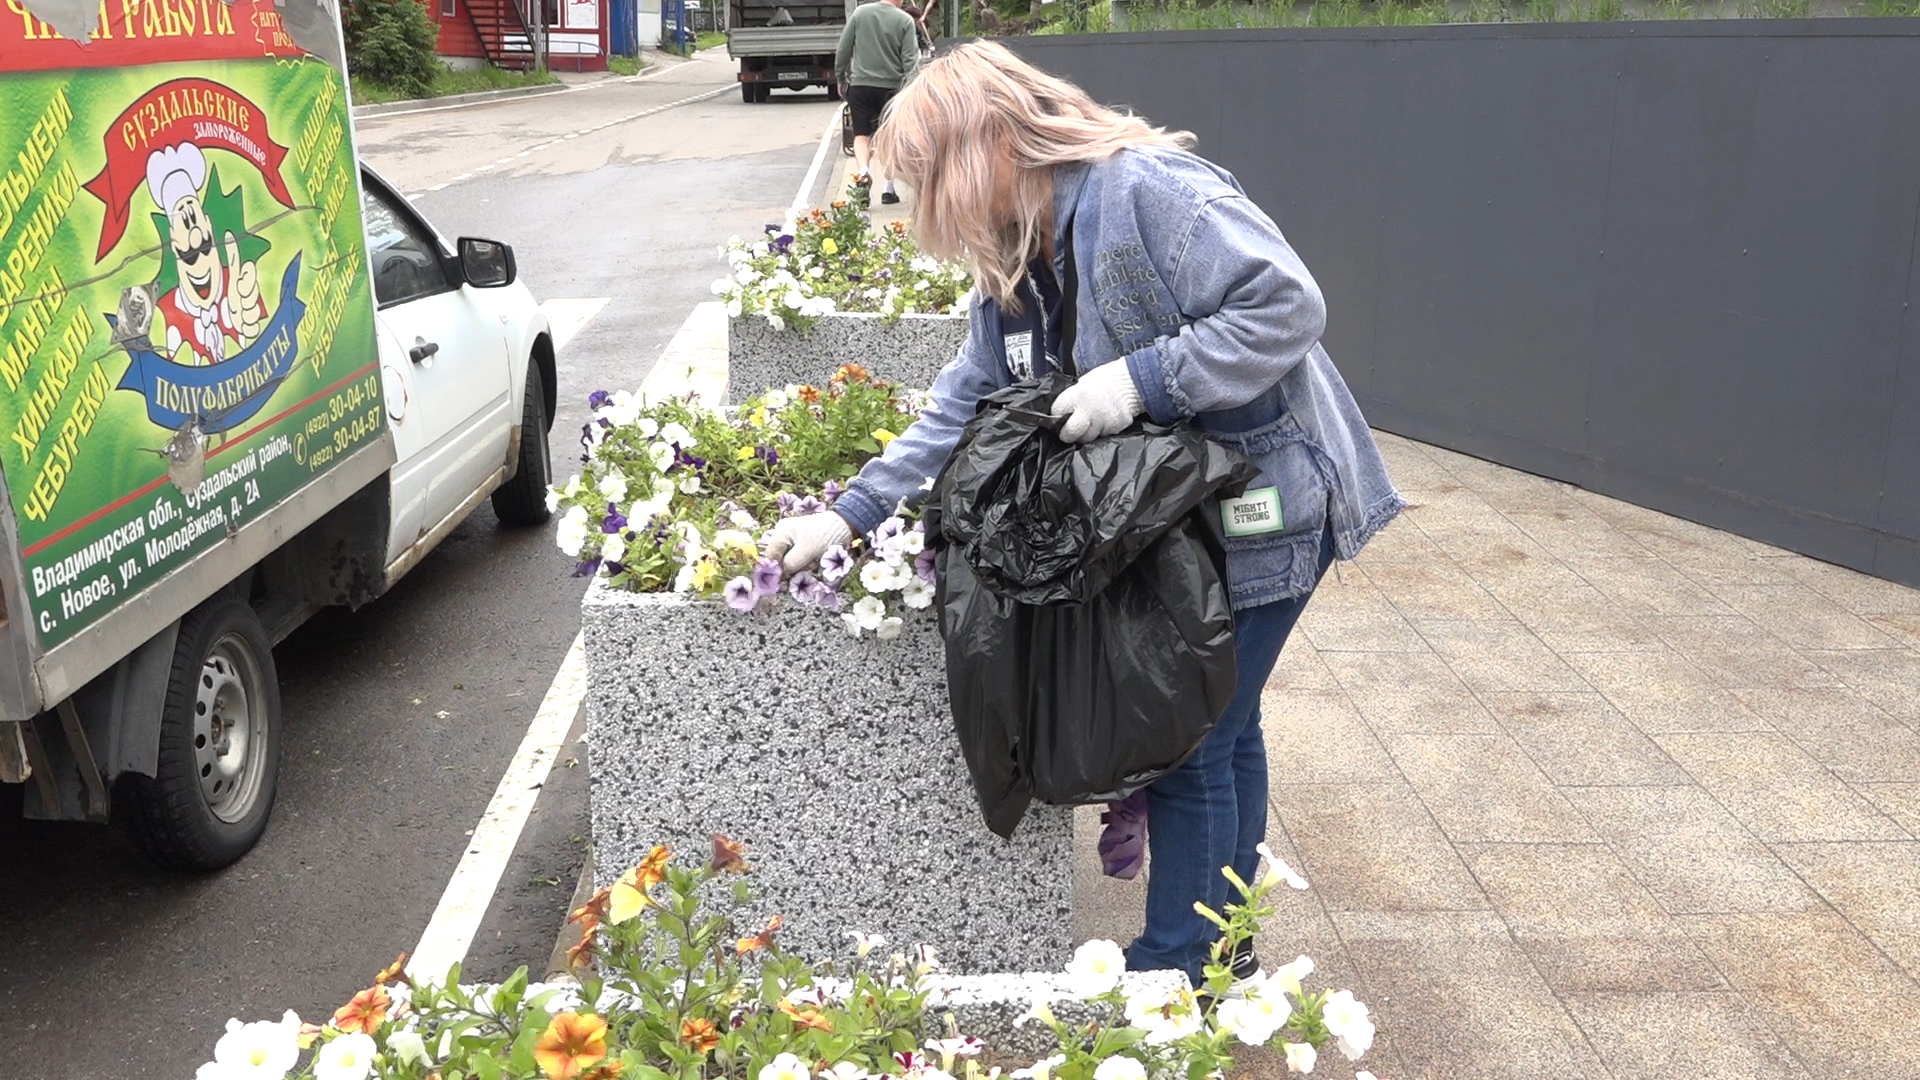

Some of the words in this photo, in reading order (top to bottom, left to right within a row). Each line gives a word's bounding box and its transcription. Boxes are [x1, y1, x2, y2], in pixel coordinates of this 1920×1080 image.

[0, 88, 75, 241] ЛЬМЕНИ
[122, 88, 250, 151] СУЗДАЛЬСКИЕ
[193, 122, 267, 166] ЗАМОРОЖЕННЫЕ
[295, 67, 338, 174] ШАШЛЫК
[307, 112, 344, 207] РОЗАНЫ
[319, 164, 350, 240] САМСА
[0, 265, 68, 393] МАНТЫ
[155, 323, 292, 415] ПОЛУФАБРИКАТЫ
[11, 304, 95, 465] ХИНКАЛИ
[305, 411, 329, 440] (4922)
[329, 375, 378, 422] 30-04-10
[23, 360, 111, 522] ЧЕБУРЕКИ
[309, 444, 334, 473] (4922)
[333, 405, 380, 453] 30-04-87
[32, 516, 145, 598] Владимирская
[148, 496, 183, 531] обл.,
[185, 448, 257, 511] Суздальский
[259, 435, 292, 472] район,
[1233, 501, 1268, 514] MIGHTY
[1234, 511, 1271, 524] STRONG
[40, 610, 57, 633] с.
[60, 573, 116, 620] Новое,
[119, 557, 142, 589] ул.
[145, 505, 228, 567] Молодёжная,
[230, 496, 243, 520] д.
